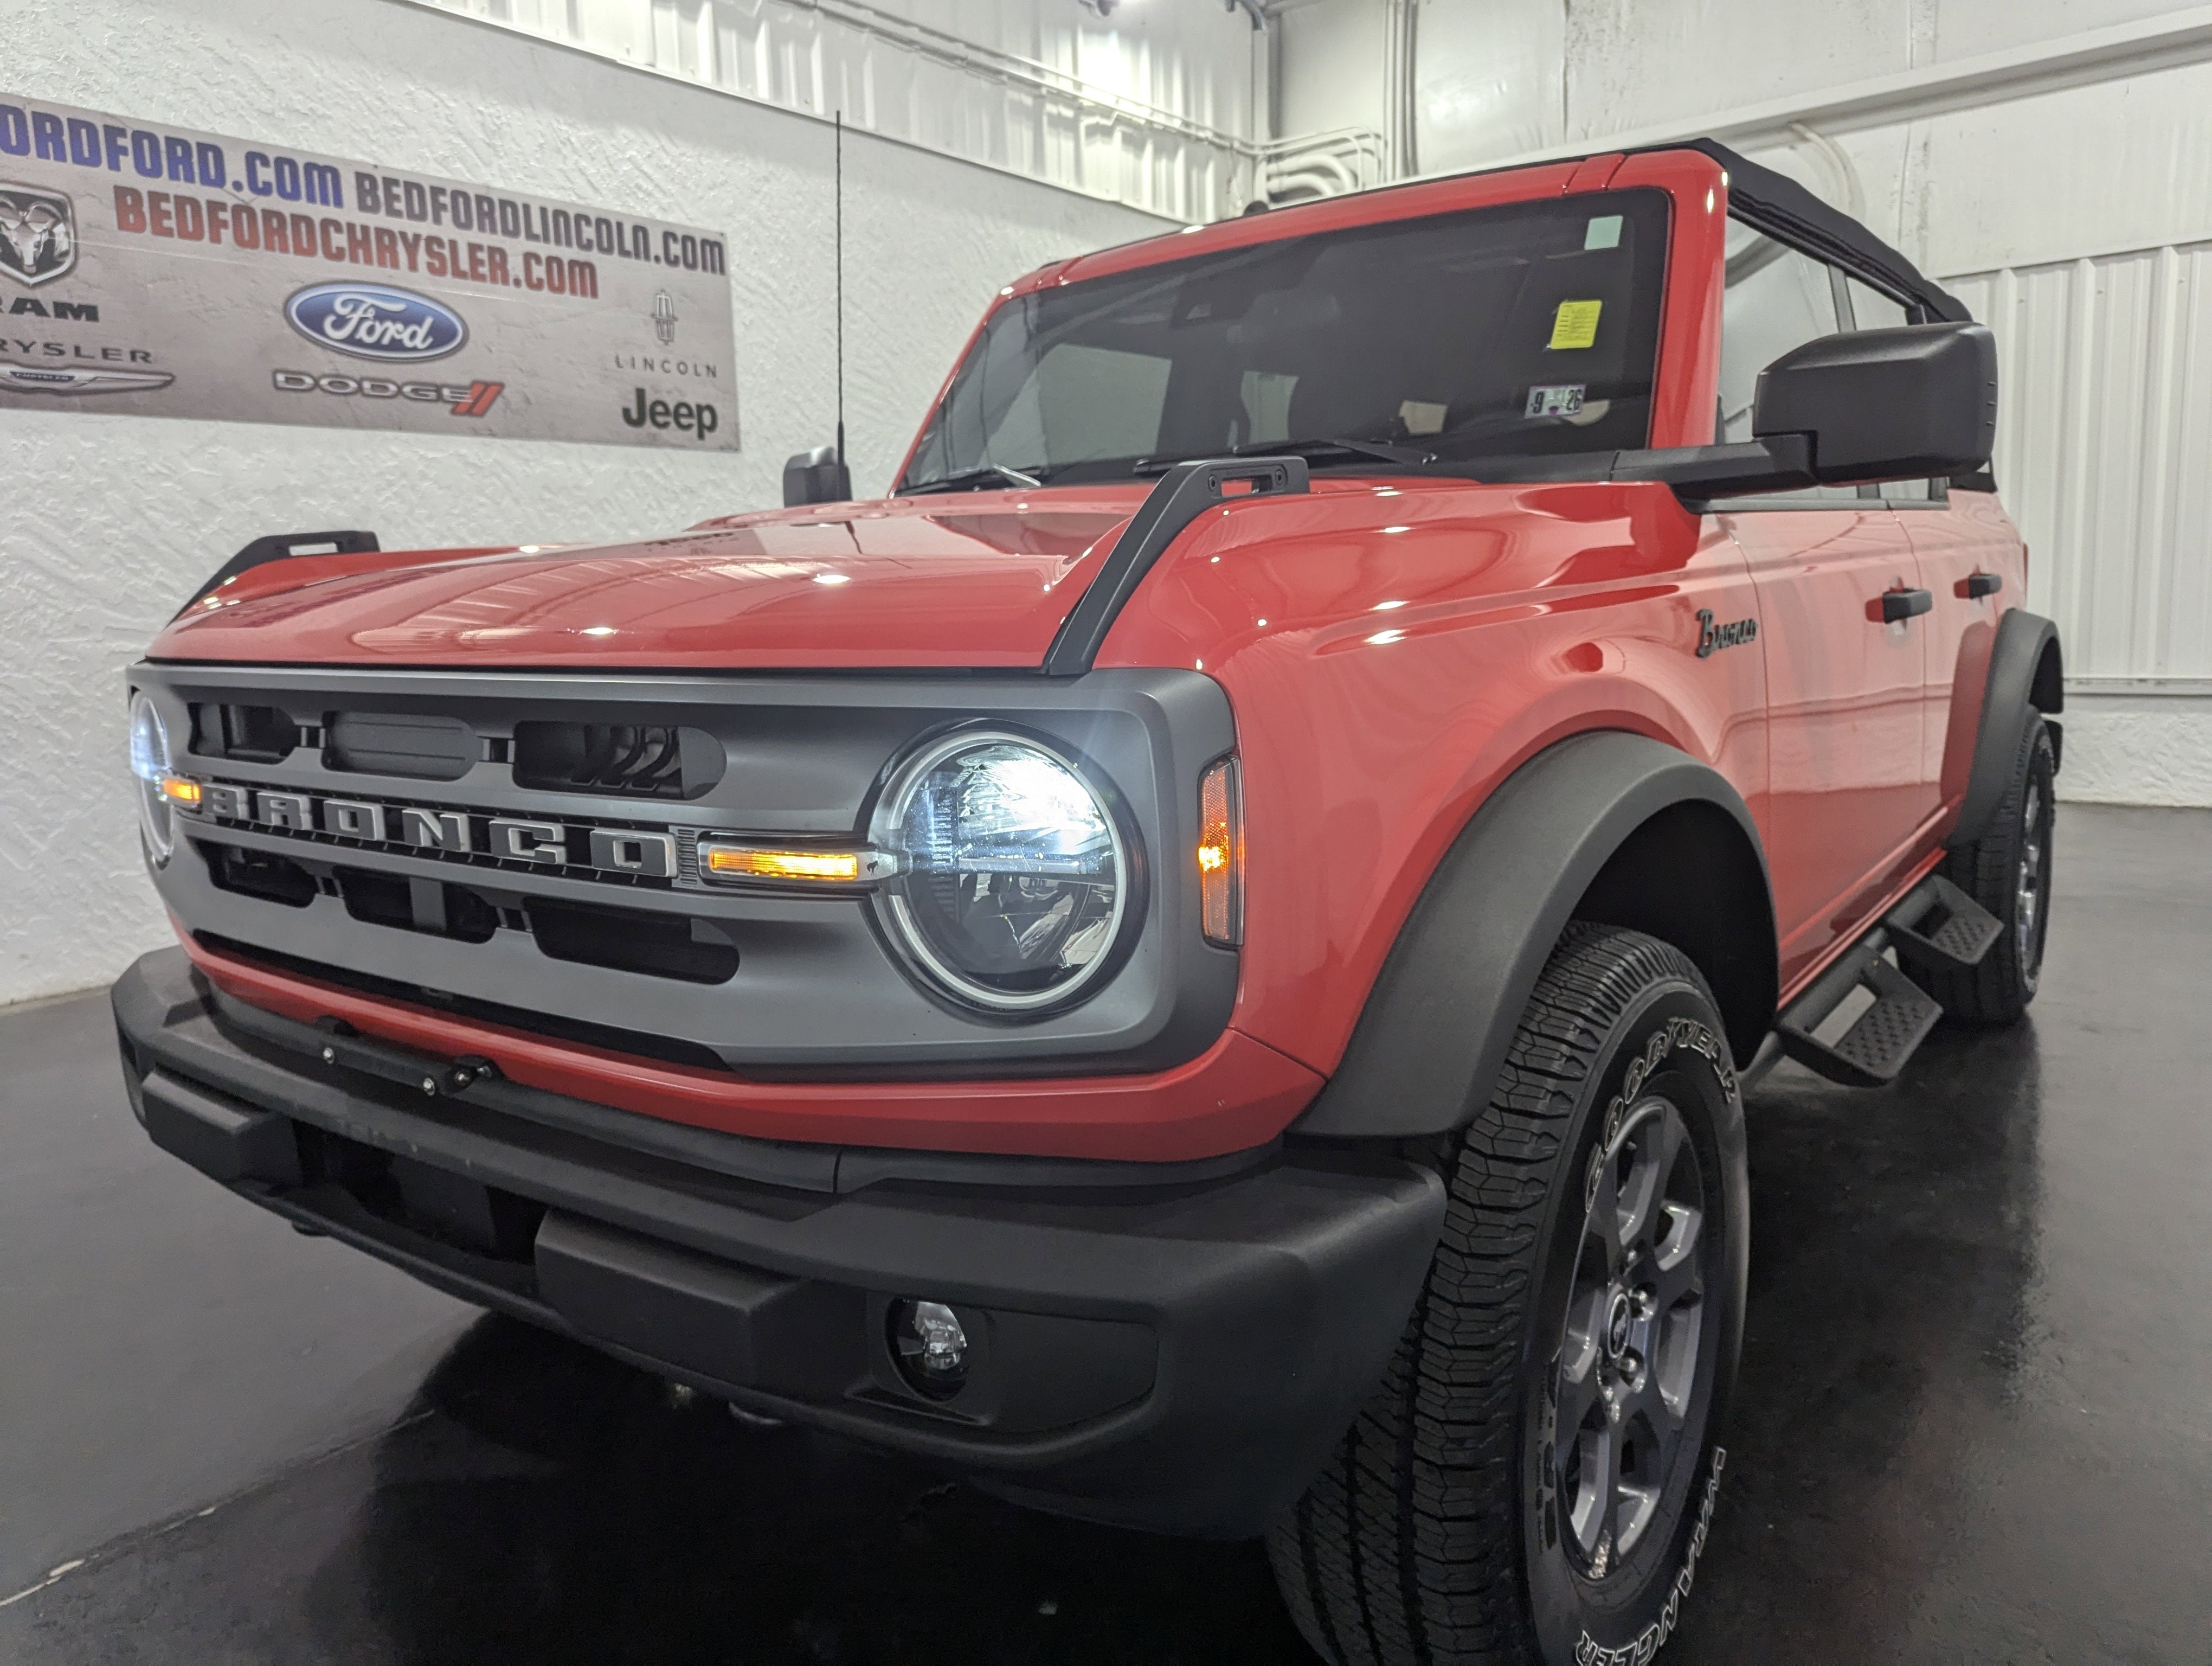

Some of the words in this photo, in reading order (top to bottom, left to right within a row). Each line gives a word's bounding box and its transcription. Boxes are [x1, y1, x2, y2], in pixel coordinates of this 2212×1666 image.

[113, 185, 599, 299] BEDFORDCHRYSLER.COM
[354, 171, 726, 275] BEDFORDLINCOLN.COM
[0, 296, 100, 322] AM
[324, 293, 434, 350] Ford
[273, 370, 472, 404] DODGE
[615, 355, 717, 378] LINCOLN
[622, 387, 718, 438] Jeep
[200, 782, 678, 878] BRONCO
